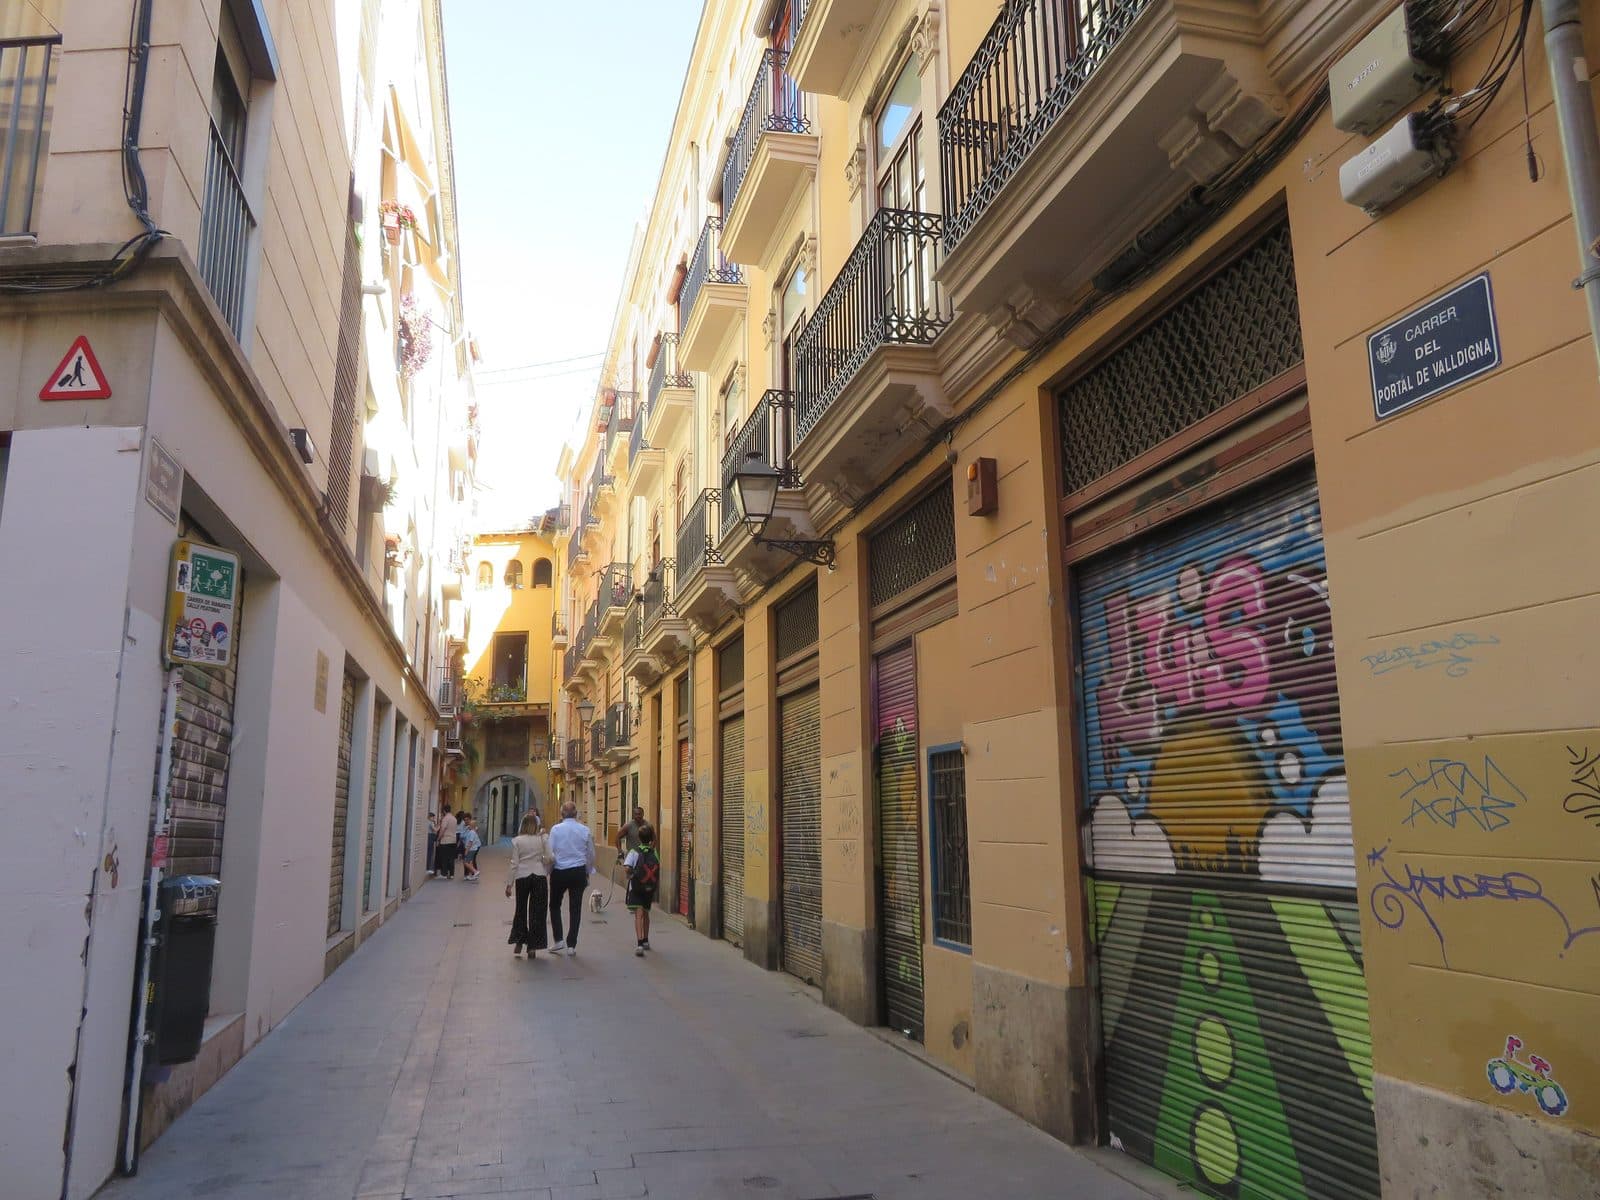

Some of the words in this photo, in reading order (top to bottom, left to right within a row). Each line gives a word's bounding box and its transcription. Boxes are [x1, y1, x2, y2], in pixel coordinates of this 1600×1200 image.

[1405, 306, 1457, 341] CARRER
[1415, 339, 1441, 360] DEL
[1378, 375, 1414, 405] PORTAL
[1416, 366, 1430, 386] DE
[1432, 338, 1492, 377] VALLDIGNA
